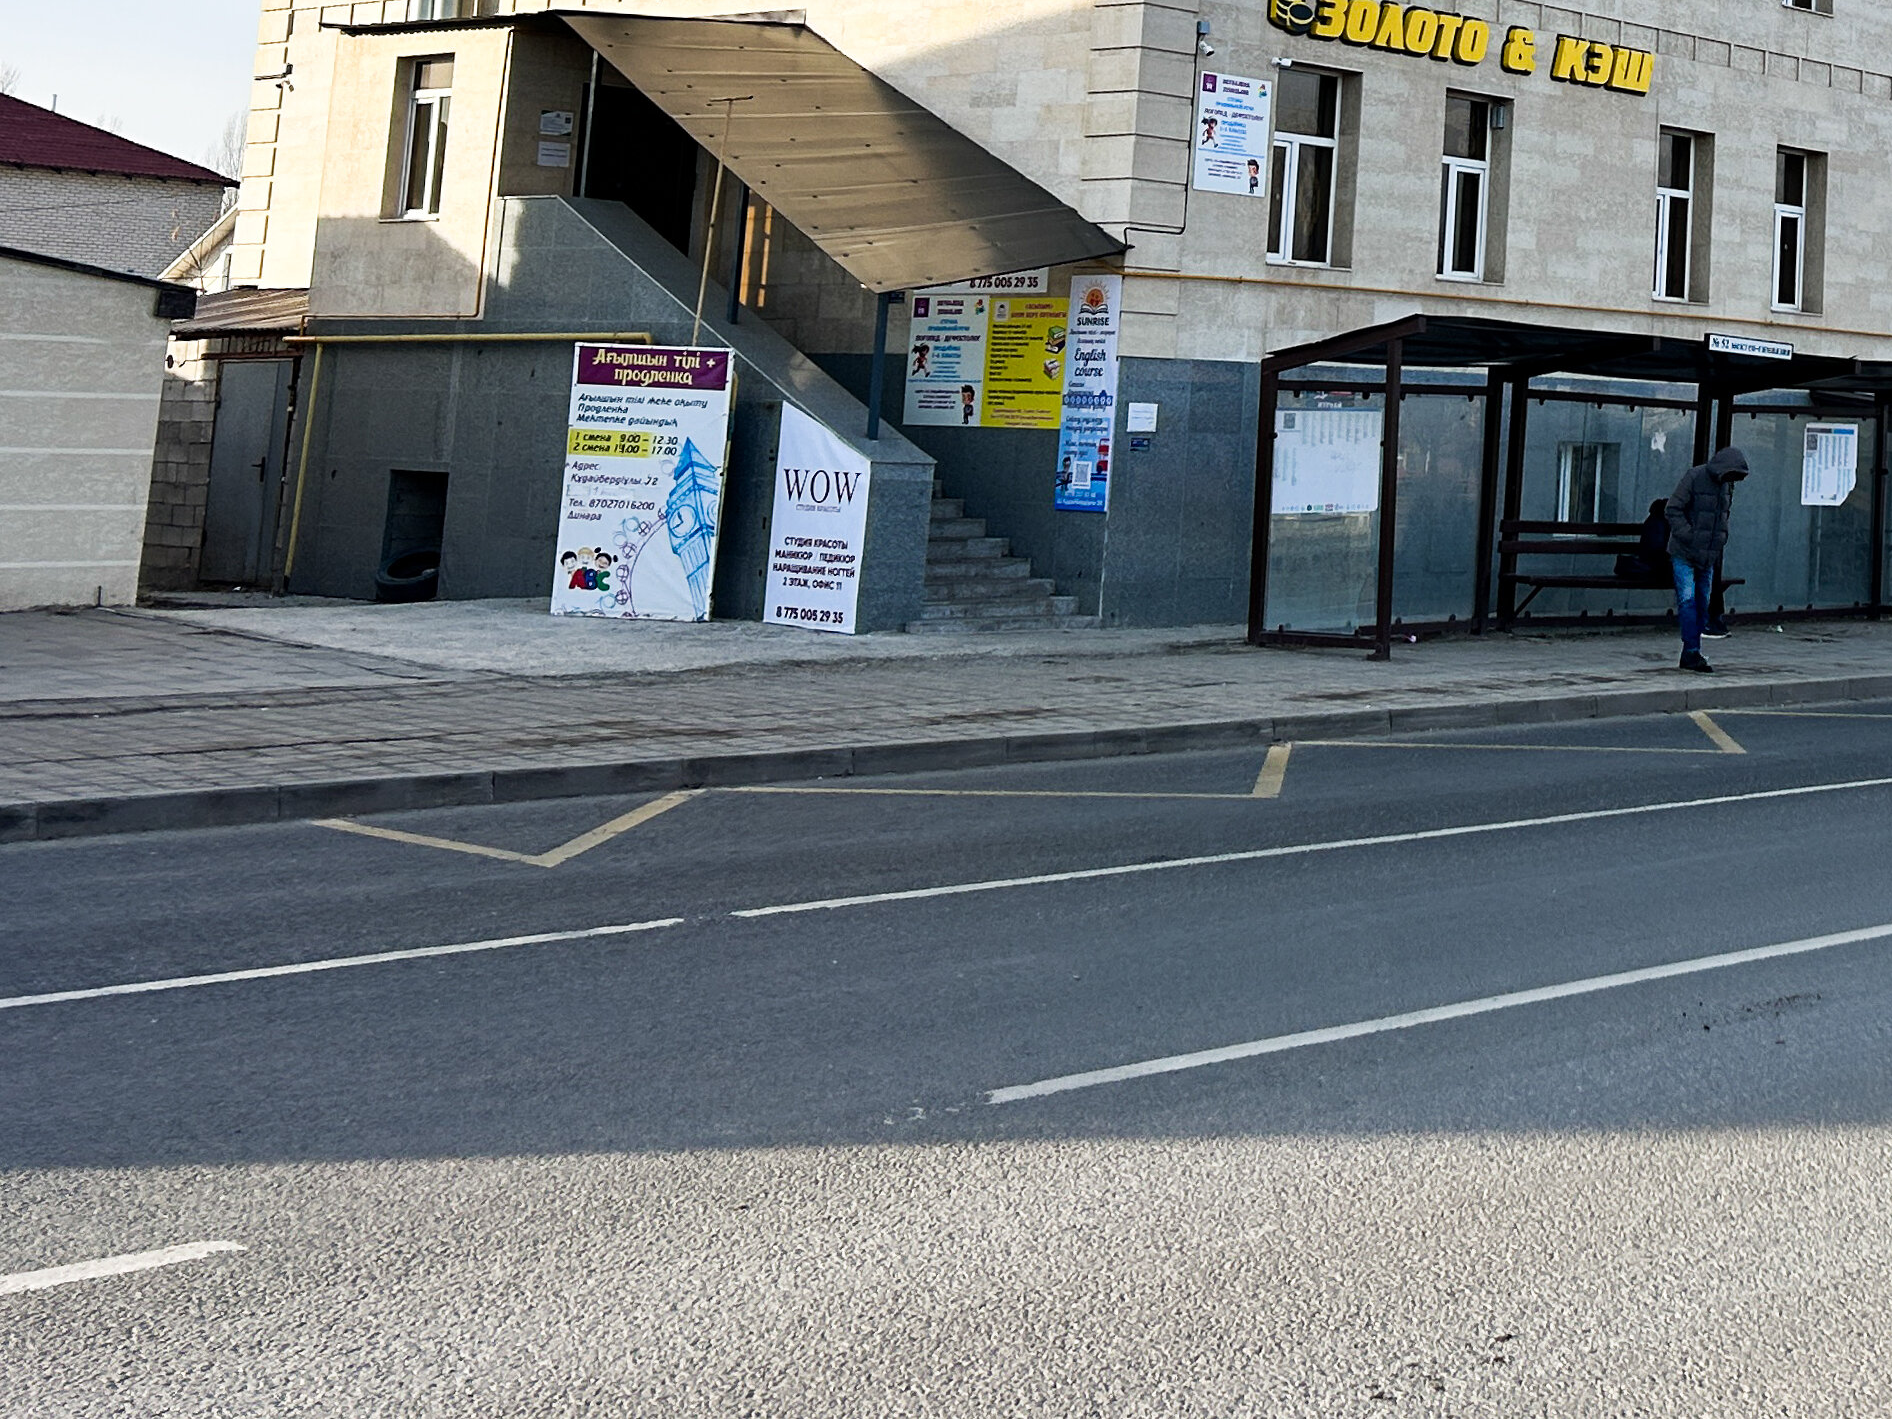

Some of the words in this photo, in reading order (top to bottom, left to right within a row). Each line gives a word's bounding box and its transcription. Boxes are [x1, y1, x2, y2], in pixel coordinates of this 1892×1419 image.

[1502, 26, 1537, 75] &
[1551, 34, 1656, 95] КЭШ
[994, 276, 1012, 288] 005
[1014, 276, 1026, 288] 29
[1027, 276, 1039, 288] 35
[1077, 317, 1110, 326] SUNRISE
[673, 351, 701, 369] тілі
[1074, 347, 1107, 367] English
[614, 368, 693, 386] продленка
[1074, 366, 1104, 377] course
[577, 403, 629, 414] Продленка
[575, 433, 580, 441] 1
[583, 434, 612, 442] смена
[573, 442, 580, 451] 2
[582, 443, 611, 452] смена
[784, 468, 862, 506] WOW
[588, 499, 655, 511] 87027016200
[567, 511, 603, 521] Динара
[784, 536, 813, 548] СТУДИЯ
[814, 538, 848, 550] КРАСОТЫ
[775, 549, 813, 561] МАНИКЮР
[819, 552, 856, 564] ПЕДИКЮР
[772, 562, 827, 577] НАРАЩИВАНИЕ
[827, 566, 855, 578] НОГТЕЙ
[569, 567, 611, 591] ABC
[782, 577, 787, 586] 2
[812, 579, 835, 590] ОФИС
[776, 606, 782, 617] 8
[784, 607, 799, 620] 775
[800, 608, 818, 622] 005
[820, 610, 831, 622] 29
[832, 611, 844, 624] 35
